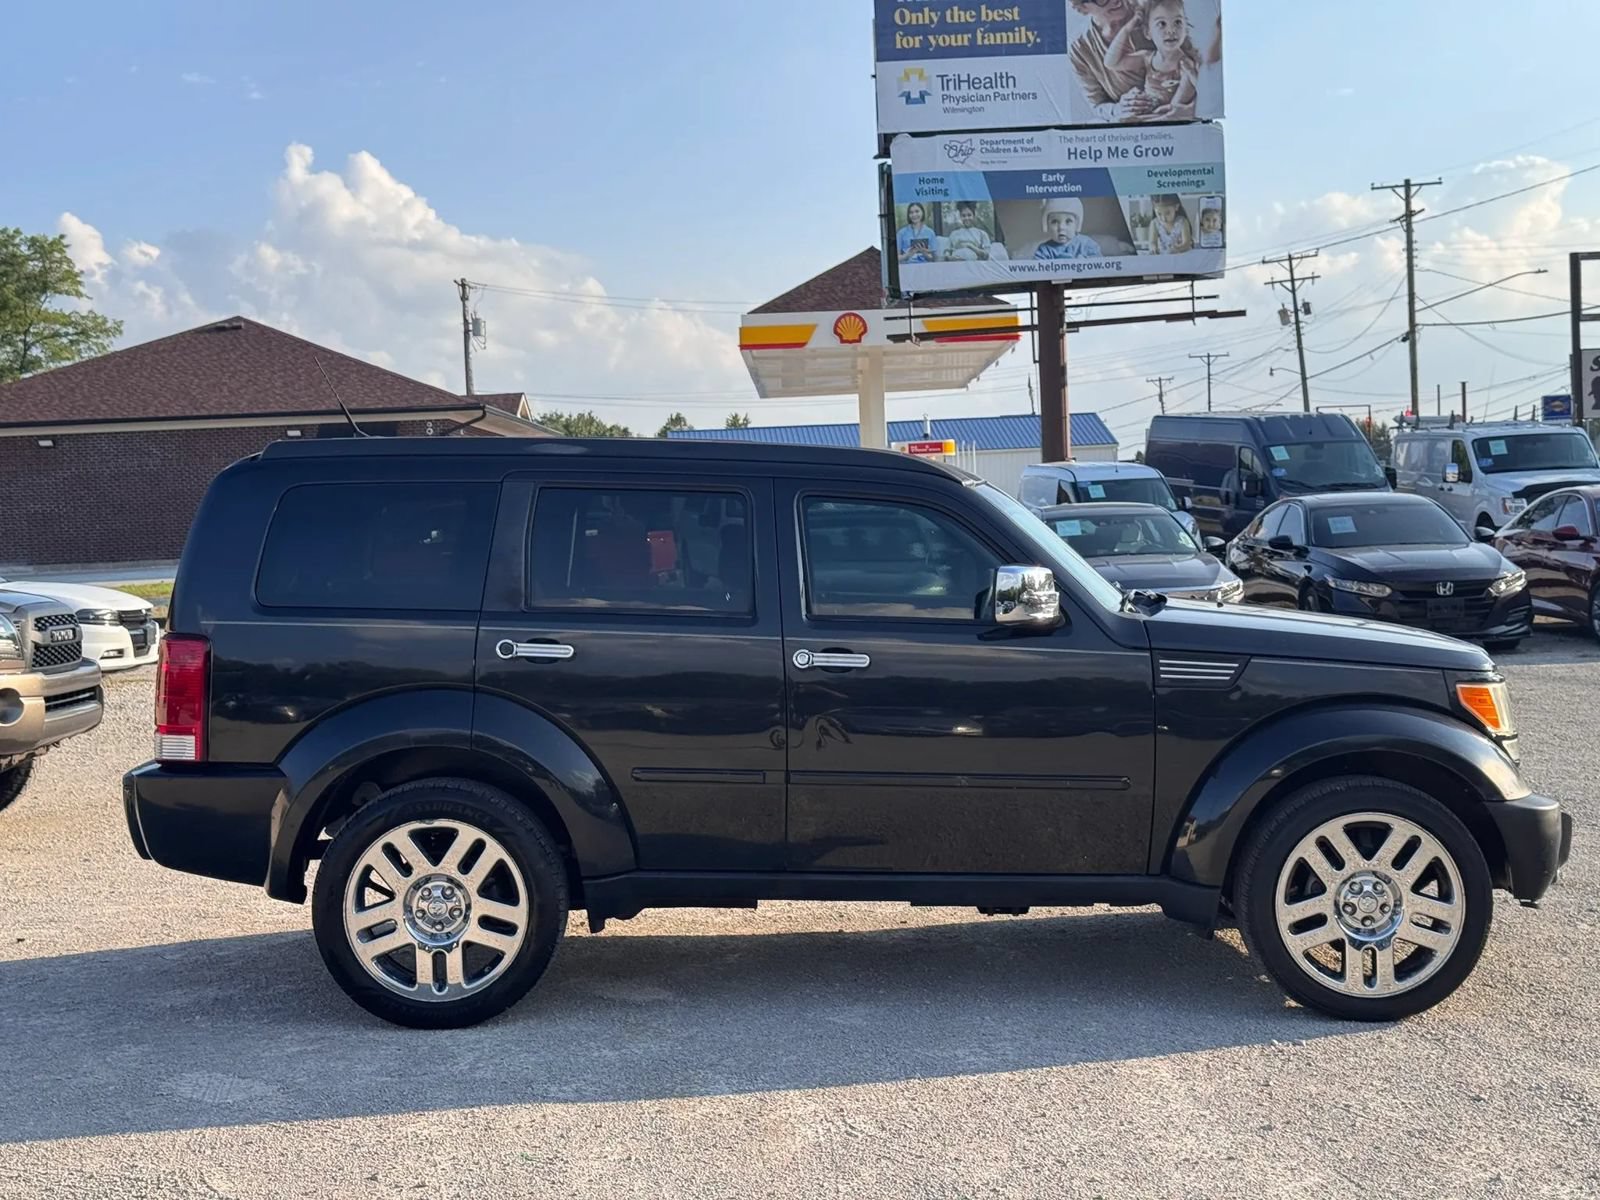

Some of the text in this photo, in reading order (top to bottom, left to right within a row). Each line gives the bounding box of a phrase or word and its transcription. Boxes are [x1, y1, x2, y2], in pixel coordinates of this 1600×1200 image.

[894, 4, 1021, 28] Only the best
[895, 26, 1041, 51] for your family.
[936, 72, 1016, 91] TriHealth
[942, 91, 1038, 106] Physician Partners
[942, 106, 985, 115] Wilmington
[979, 137, 1034, 147] Department of
[1059, 135, 1073, 144] The
[1075, 134, 1097, 143] heart
[1099, 134, 1107, 143] of
[1108, 133, 1140, 143] thriving
[980, 146, 1012, 154] Children
[1020, 145, 1042, 153] Youth
[1067, 145, 1174, 162] Help Me Grow
[1147, 167, 1214, 178] Developmental
[918, 176, 945, 186] Home
[1042, 173, 1066, 184] Early
[1156, 178, 1206, 189] Screenings
[914, 185, 949, 197] Visiting
[1025, 183, 1082, 194] Intervention
[1009, 261, 1122, 273] www.helpmegrow.org
